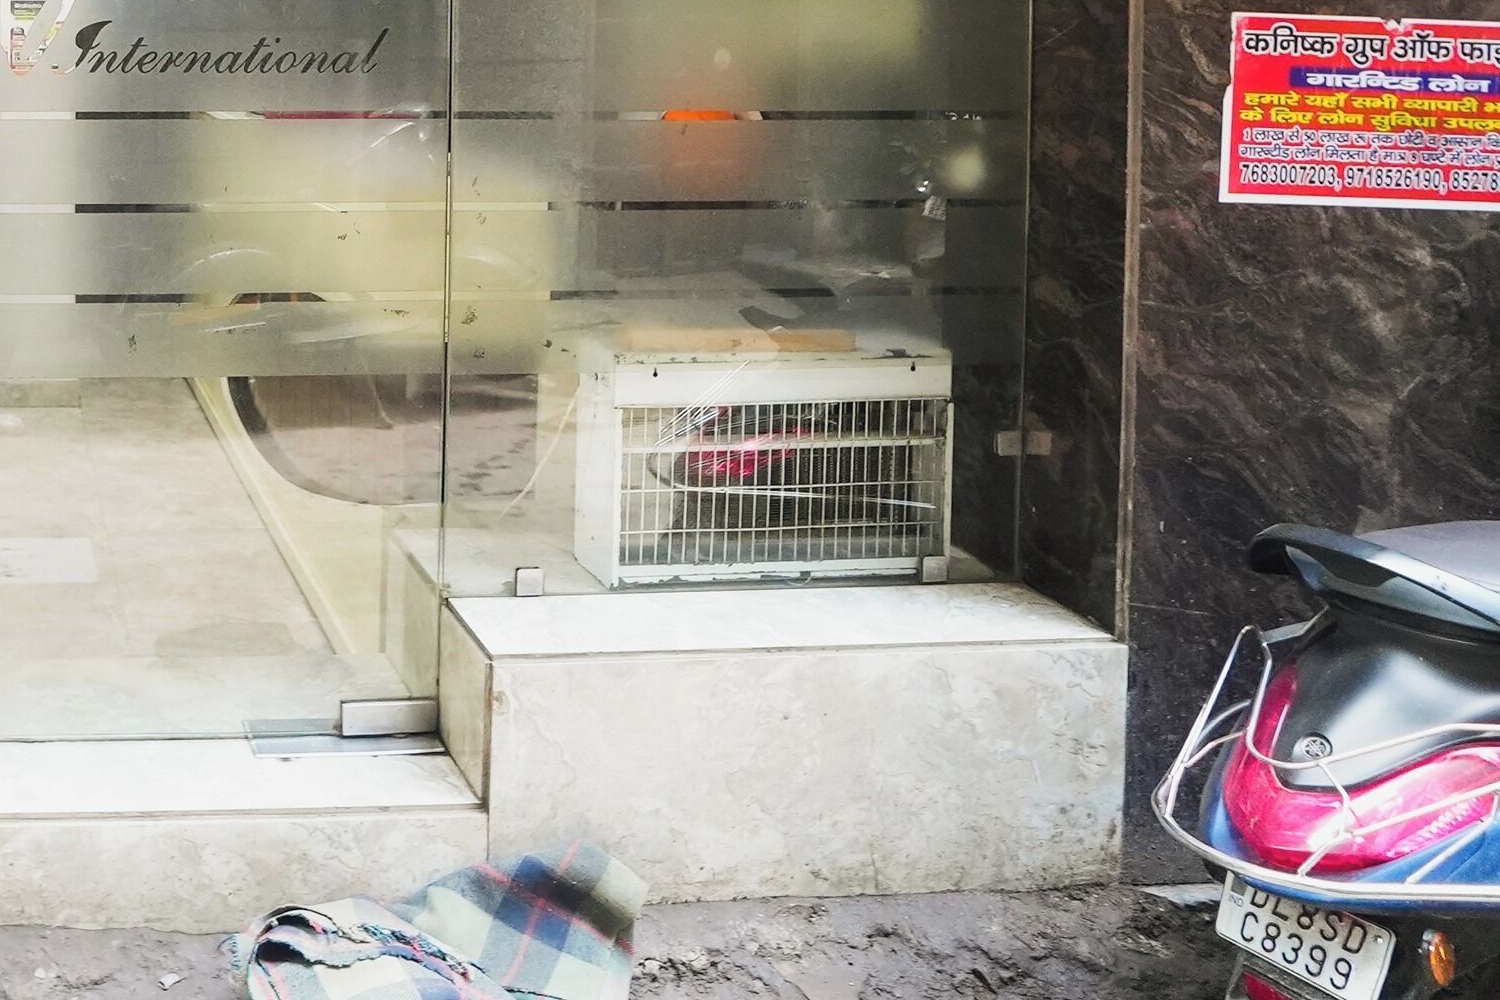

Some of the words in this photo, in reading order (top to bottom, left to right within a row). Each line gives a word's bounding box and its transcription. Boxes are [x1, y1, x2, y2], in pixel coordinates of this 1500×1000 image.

[53, 19, 389, 77] International
[1244, 25, 1338, 54] कनिष्क
[1345, 36, 1388, 65] ग्रुप
[1393, 33, 1453, 59] ऑफ
[1428, 74, 1491, 93] लोन
[1244, 90, 1301, 106] हमारे
[1352, 93, 1398, 110] सभी
[1404, 97, 1479, 113] व्यापारी
[1240, 106, 1264, 121] के
[1270, 106, 1314, 124] लिए
[1317, 109, 1364, 125] लोन
[1369, 111, 1437, 131] सुविधा
[1242, 164, 1340, 188] 7683007203,
[1347, 167, 1446, 191] 9718526190,
[1241, 912, 1352, 990] C8399
